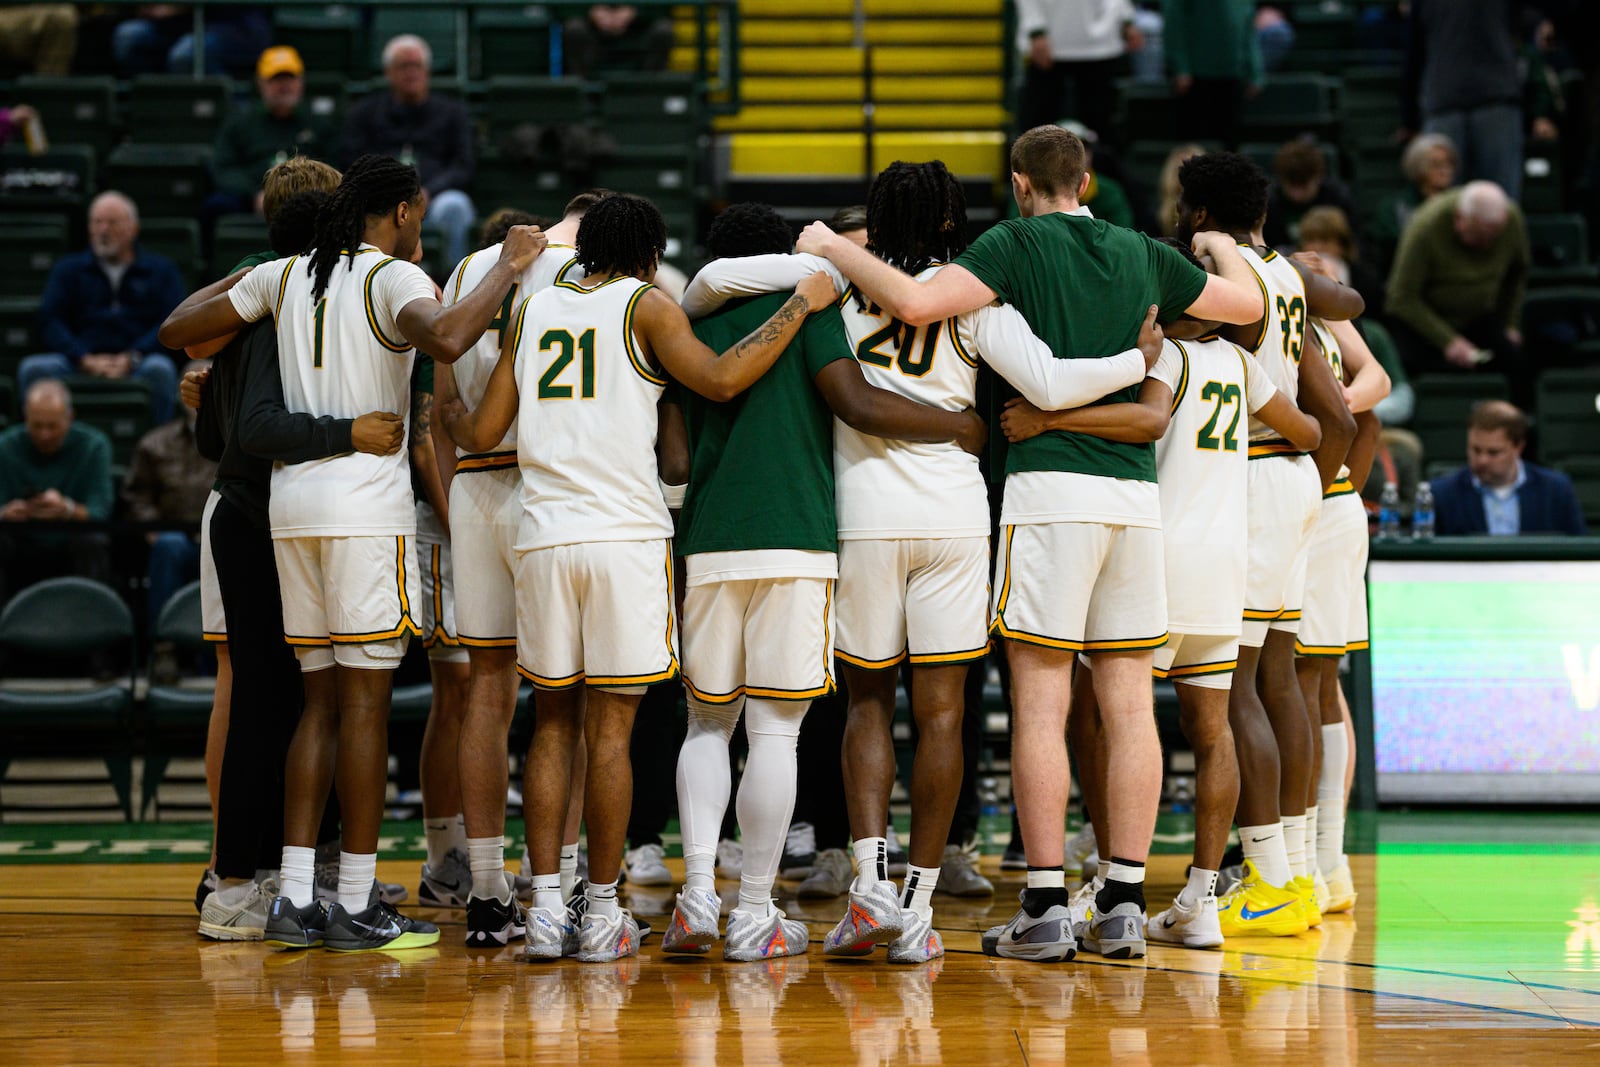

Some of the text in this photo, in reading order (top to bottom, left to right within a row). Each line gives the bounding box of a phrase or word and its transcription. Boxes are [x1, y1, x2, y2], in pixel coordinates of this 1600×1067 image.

[313, 297, 327, 369] 1
[537, 327, 597, 401] 21
[856, 301, 943, 378] 20
[1276, 293, 1305, 364] 33
[1196, 380, 1241, 452] 22
